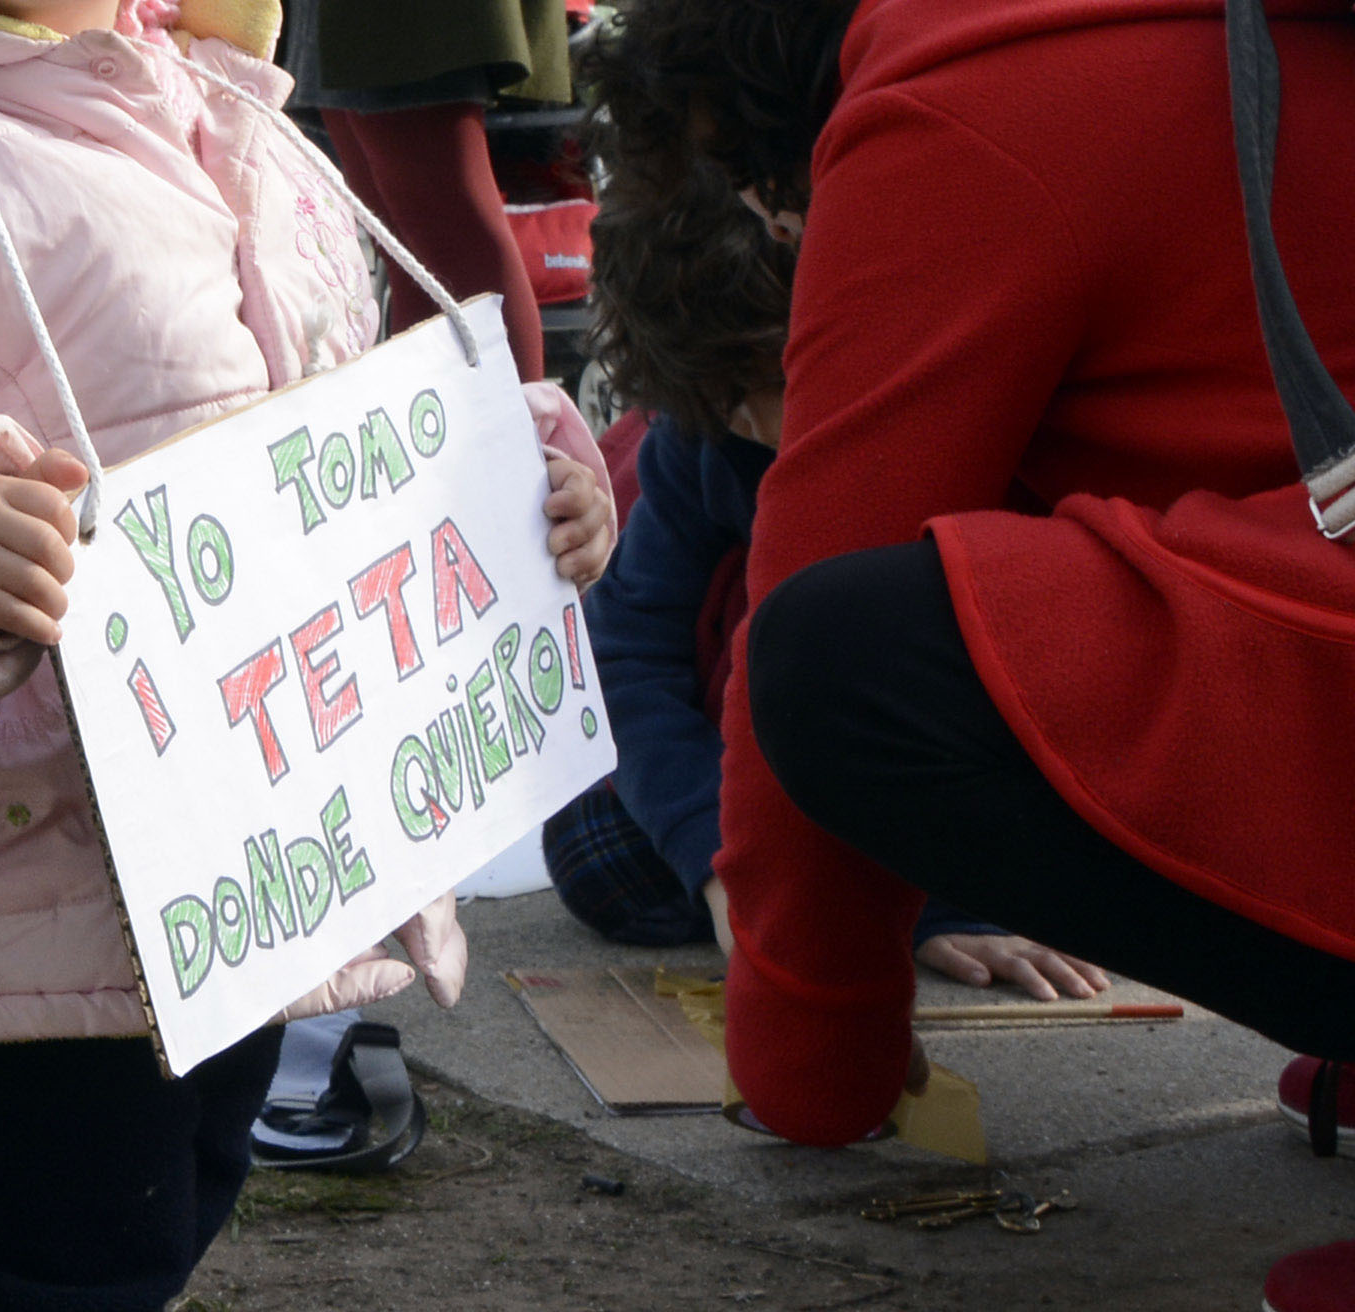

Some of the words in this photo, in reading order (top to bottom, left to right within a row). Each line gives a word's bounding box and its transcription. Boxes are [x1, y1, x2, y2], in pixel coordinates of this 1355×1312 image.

[268, 388, 447, 535] TOMO
[217, 517, 499, 786] TETA
[161, 785, 376, 999] DONDE
